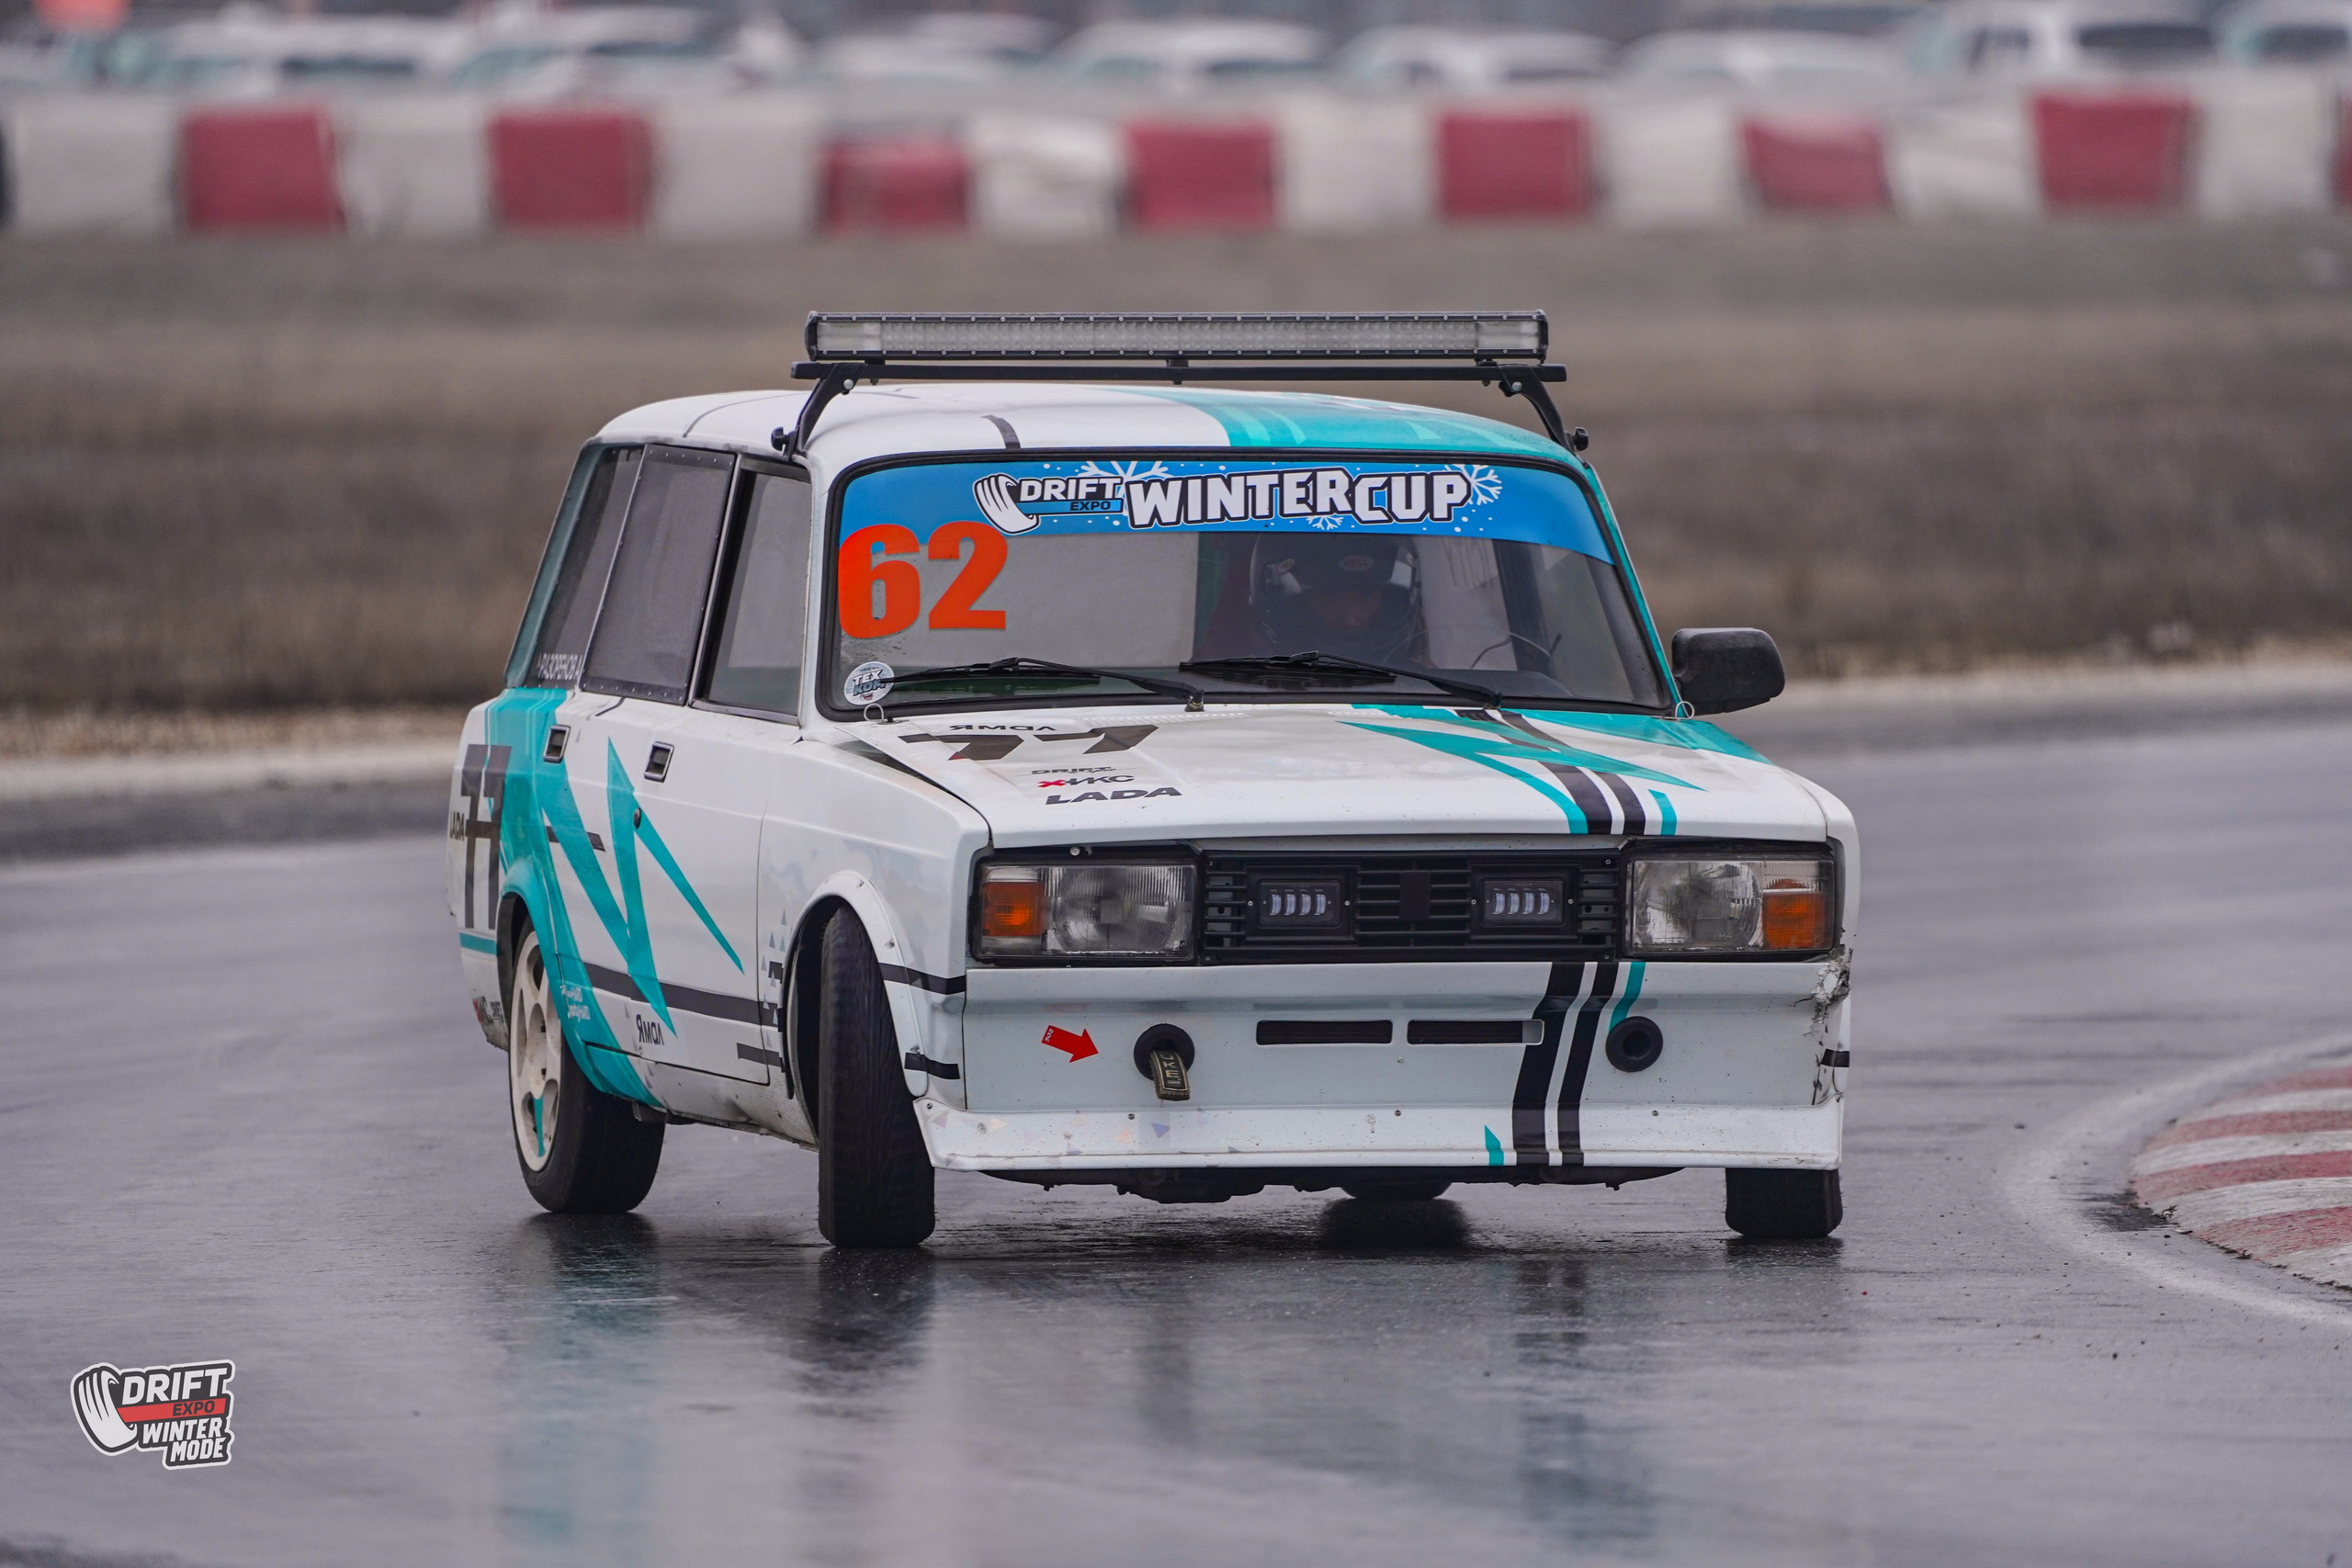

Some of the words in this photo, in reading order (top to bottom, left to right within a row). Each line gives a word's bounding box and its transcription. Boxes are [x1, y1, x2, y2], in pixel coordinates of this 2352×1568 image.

[1019, 477, 1122, 502] DRIFT
[1069, 501, 1111, 511] EXPO
[838, 521, 1008, 638] 62
[1045, 787, 1182, 805] LADA
